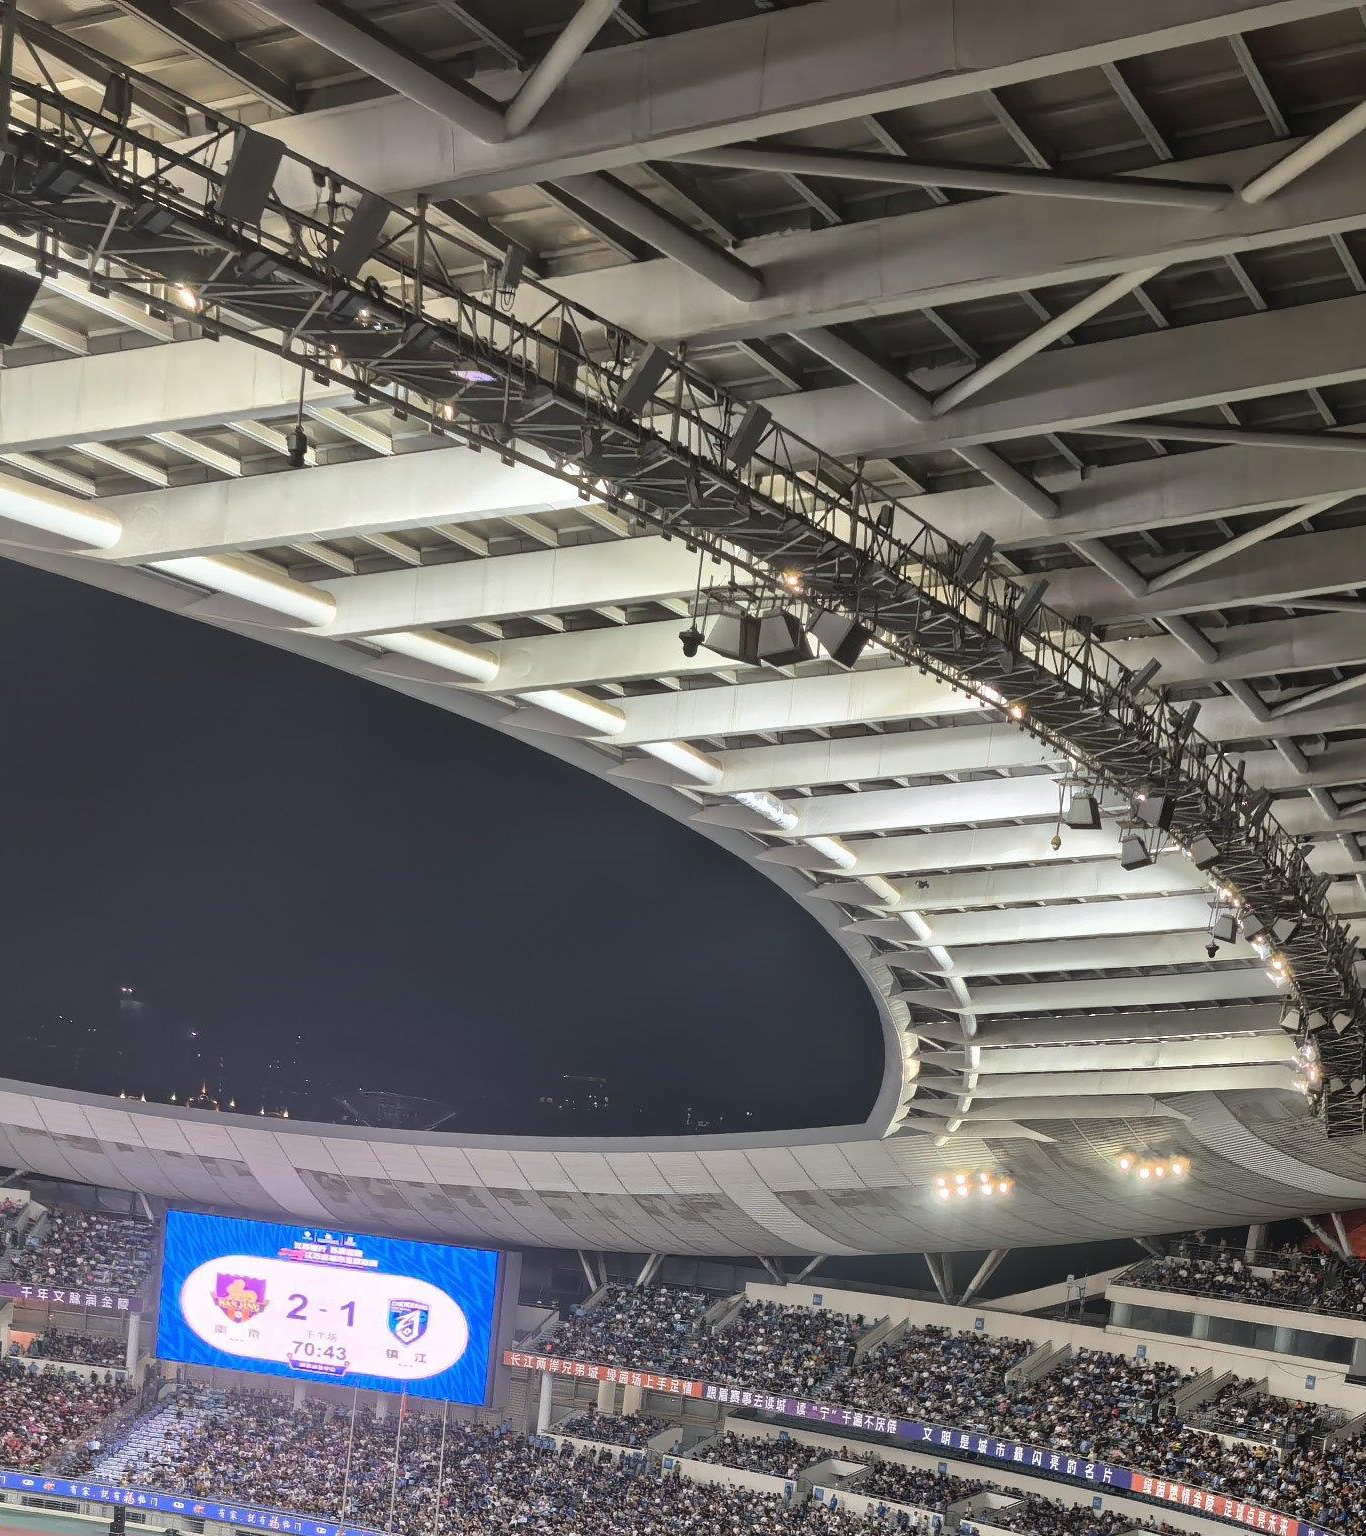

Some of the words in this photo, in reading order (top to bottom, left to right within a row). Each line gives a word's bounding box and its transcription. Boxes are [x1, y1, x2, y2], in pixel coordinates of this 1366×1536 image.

[286, 1293, 308, 1321] 2
[340, 1301, 355, 1327] 1
[292, 1341, 348, 1361] 70:43
[509, 1353, 598, 1380] 长江两岸兄弟城
[921, 1428, 1112, 1484] 文明是城市最闪亮的名片
